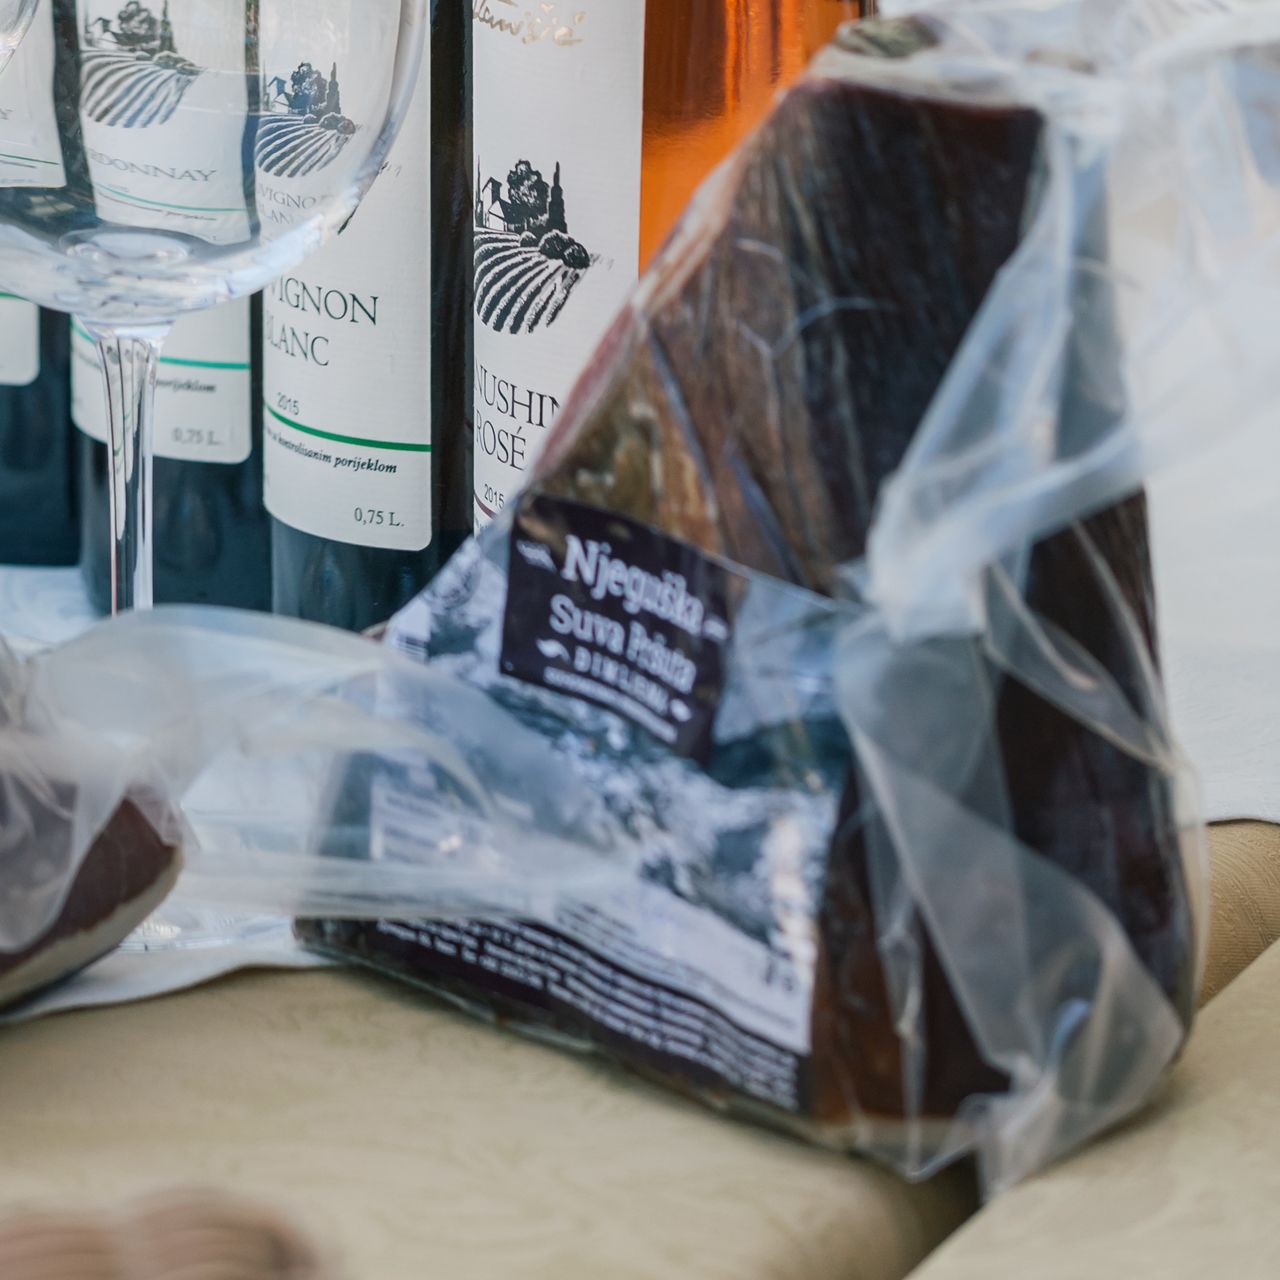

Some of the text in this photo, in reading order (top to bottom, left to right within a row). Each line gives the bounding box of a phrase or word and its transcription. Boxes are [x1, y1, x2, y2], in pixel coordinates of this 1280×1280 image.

[476, 408, 527, 472] ROSÉ
[333, 456, 397, 474] porijeklom
[484, 483, 506, 510] 2015
[354, 506, 405, 528] 0,75 L.
[549, 593, 625, 656] Suva
